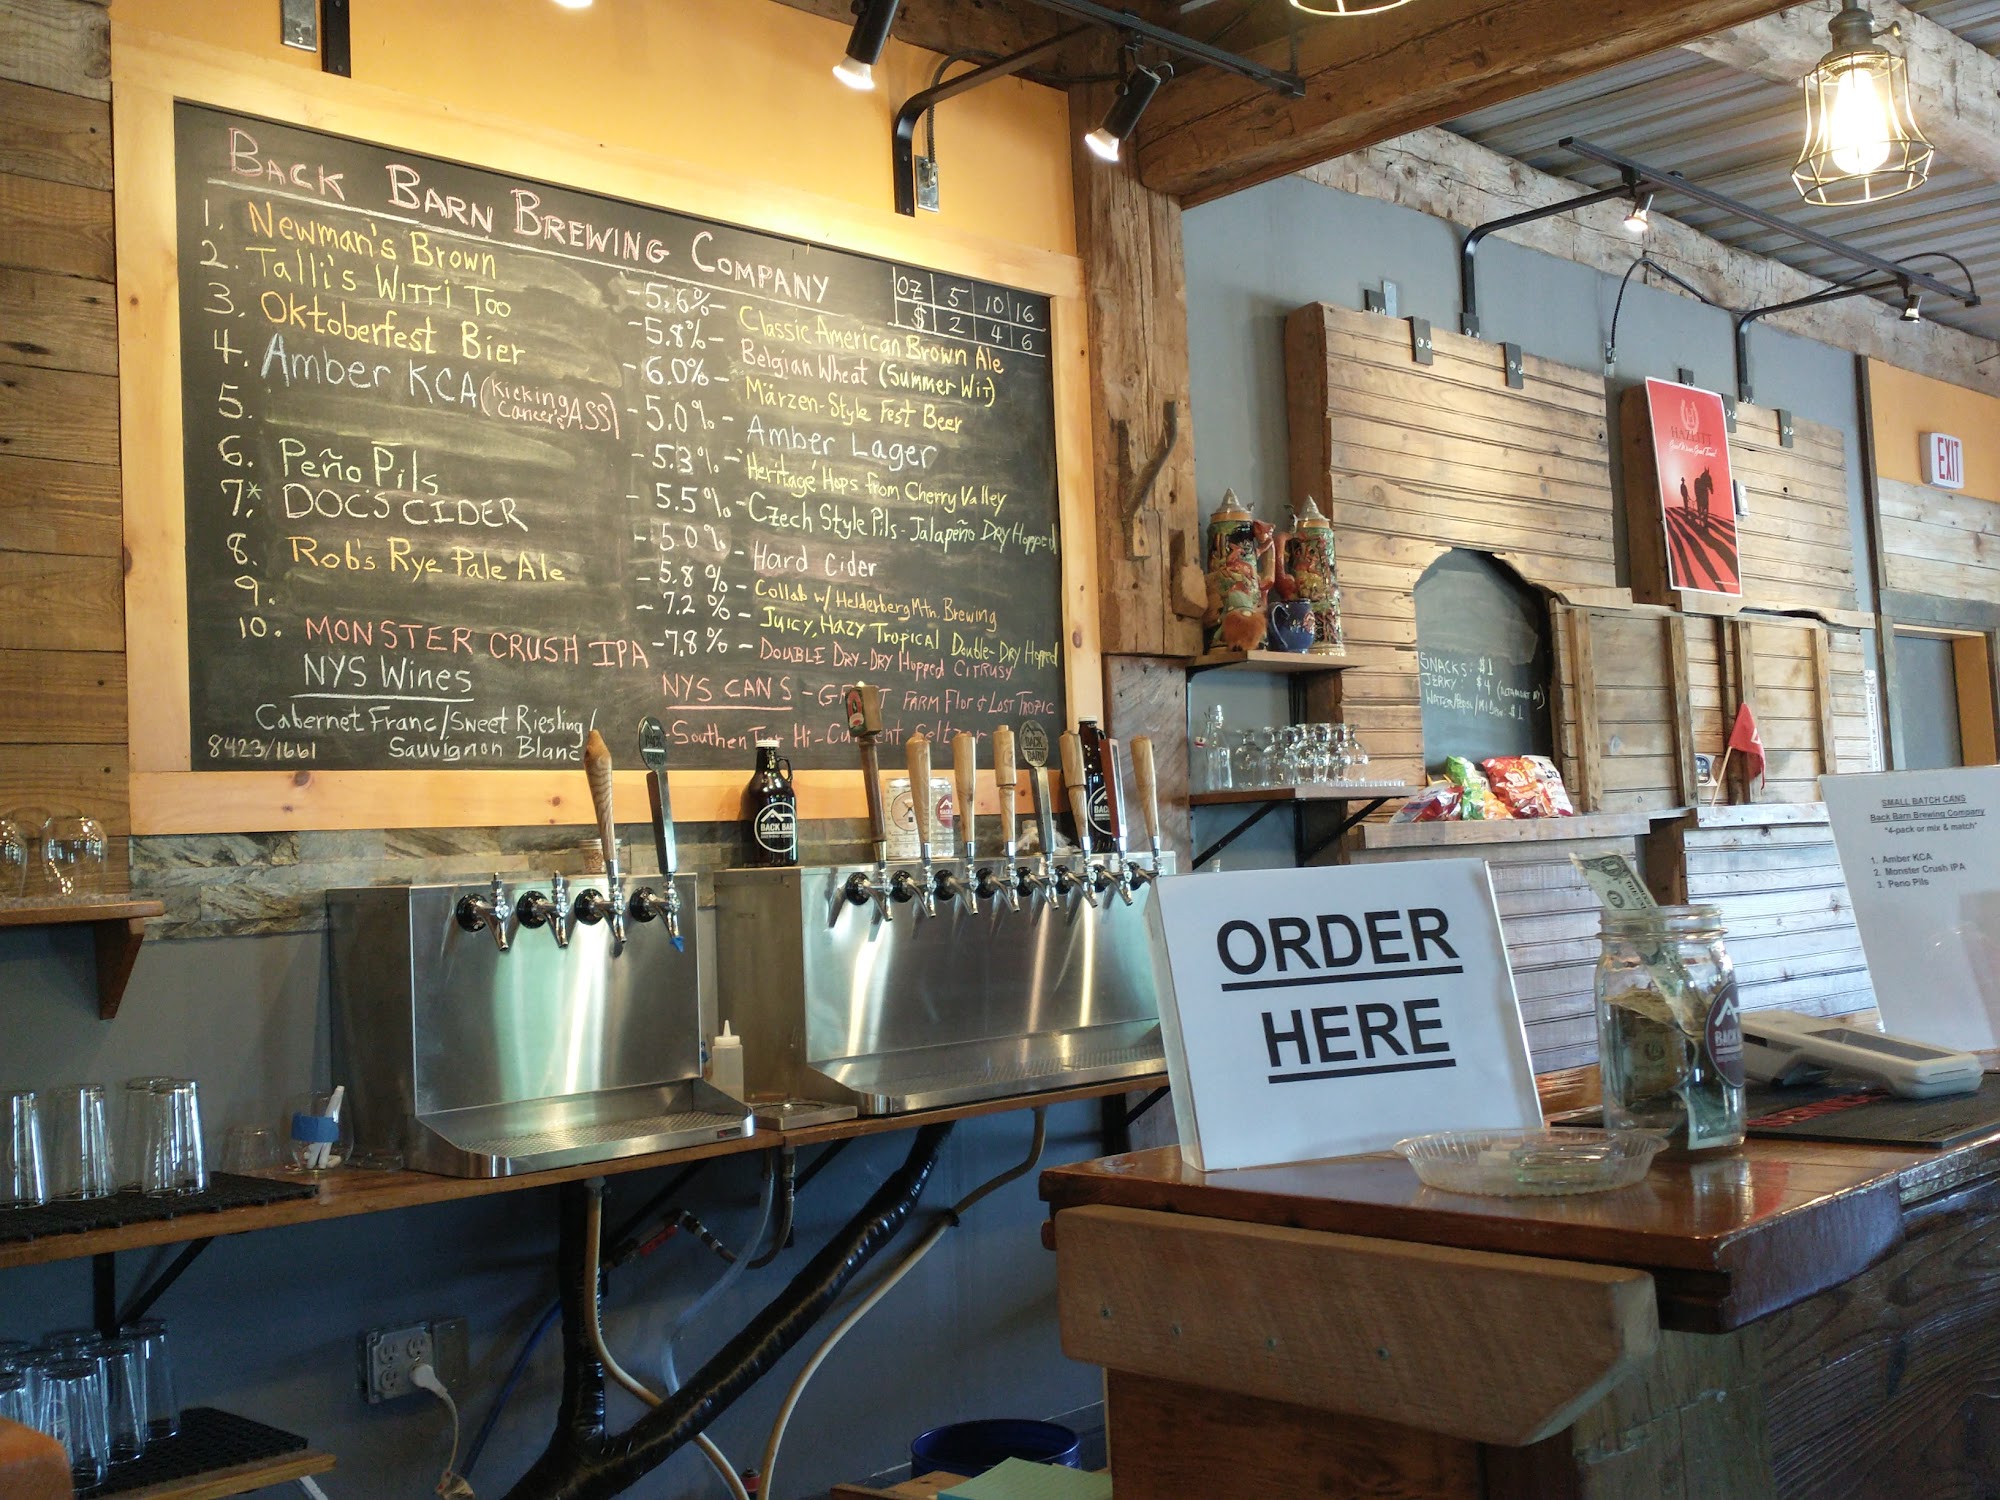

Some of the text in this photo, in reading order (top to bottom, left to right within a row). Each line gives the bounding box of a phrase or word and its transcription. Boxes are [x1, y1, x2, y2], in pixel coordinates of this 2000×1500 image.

[228, 127, 830, 304] BACK BARN BREWING COMPANY
[203, 198, 224, 231] 1.
[247, 201, 397, 260] Newman's
[410, 230, 496, 280] Brown
[739, 305, 812, 345] Classic
[815, 314, 901, 358] American
[906, 335, 967, 367] Brown
[976, 345, 1004, 374] Ale
[948, 287, 969, 308] 5
[985, 296, 1004, 314] 10
[1015, 302, 1034, 323] 16
[199, 240, 239, 270] 2.
[245, 246, 357, 291] Talli's
[464, 284, 512, 318] Too
[741, 338, 814, 380] Belgian
[818, 353, 868, 386] Wheat
[879, 360, 957, 396] (Summer
[911, 302, 1033, 351] $ 2 4 6
[204, 282, 245, 318] 3.
[260, 290, 437, 354] Oktoberfest
[461, 320, 526, 365] Bier
[880, 398, 916, 428] Fest
[923, 403, 962, 433] Beer
[213, 328, 249, 368] 4.
[260, 332, 391, 388] Amber
[408, 360, 478, 409] KCA
[498, 400, 565, 430] Cancer's
[747, 413, 836, 456] Amber
[851, 431, 937, 471] Lager
[218, 384, 253, 419] 5.
[746, 451, 817, 498] Heritage
[822, 465, 858, 495] Hops
[905, 481, 956, 514] Cherry
[961, 486, 1007, 517] Valley
[1937, 436, 1960, 483] EXIT
[217, 434, 254, 468] 6.
[278, 437, 362, 483] Peño
[370, 440, 439, 496] Pils
[748, 491, 813, 533] Czech
[819, 503, 868, 540] Style
[870, 506, 898, 540] Pils
[1011, 521, 1058, 555] Hopped
[402, 497, 529, 532] CIDER
[753, 540, 808, 573] Hard
[825, 550, 878, 577] Cider
[226, 532, 258, 567] 8.
[286, 535, 377, 571] Rob's
[387, 535, 443, 583] Rye
[451, 544, 507, 581] Pale
[517, 551, 566, 583] Ale
[755, 578, 808, 603] Collab
[814, 584, 832, 613] w/
[836, 589, 910, 621] Helderberg
[942, 596, 998, 633] Brewing
[233, 575, 276, 606] 9.
[820, 614, 866, 640] Hazy
[1025, 639, 1059, 670] Hopped
[238, 615, 283, 640] 10.
[305, 615, 474, 655] MONSTER
[490, 630, 579, 665] CRUSH
[588, 639, 650, 669] IPA
[760, 636, 826, 666] DOUBLE
[899, 649, 945, 682] Hopped
[302, 653, 473, 693] NYS Wines
[661, 672, 713, 703] NYS
[724, 675, 792, 702] CANS
[254, 703, 366, 733] Cabernet
[207, 732, 317, 761] 8423/1661
[388, 735, 582, 762] Sauvignon Blanc
[1870, 814, 1890, 822] Back
[1913, 810, 1946, 820] Brewing
[1947, 808, 1985, 818] Company
[1881, 794, 1967, 807] SMALL BATCH CANS
[760, 823, 780, 832] BACK
[1927, 824, 1941, 832] mix
[1882, 854, 1911, 864] Amber
[1912, 852, 1934, 862] KCA
[1885, 866, 1920, 876] Monster
[1922, 864, 1949, 874] Crush
[1950, 862, 1967, 872] IPA
[1912, 877, 1930, 887] Pils
[1216, 907, 1460, 976] ORDER
[1261, 998, 1451, 1067] HERE
